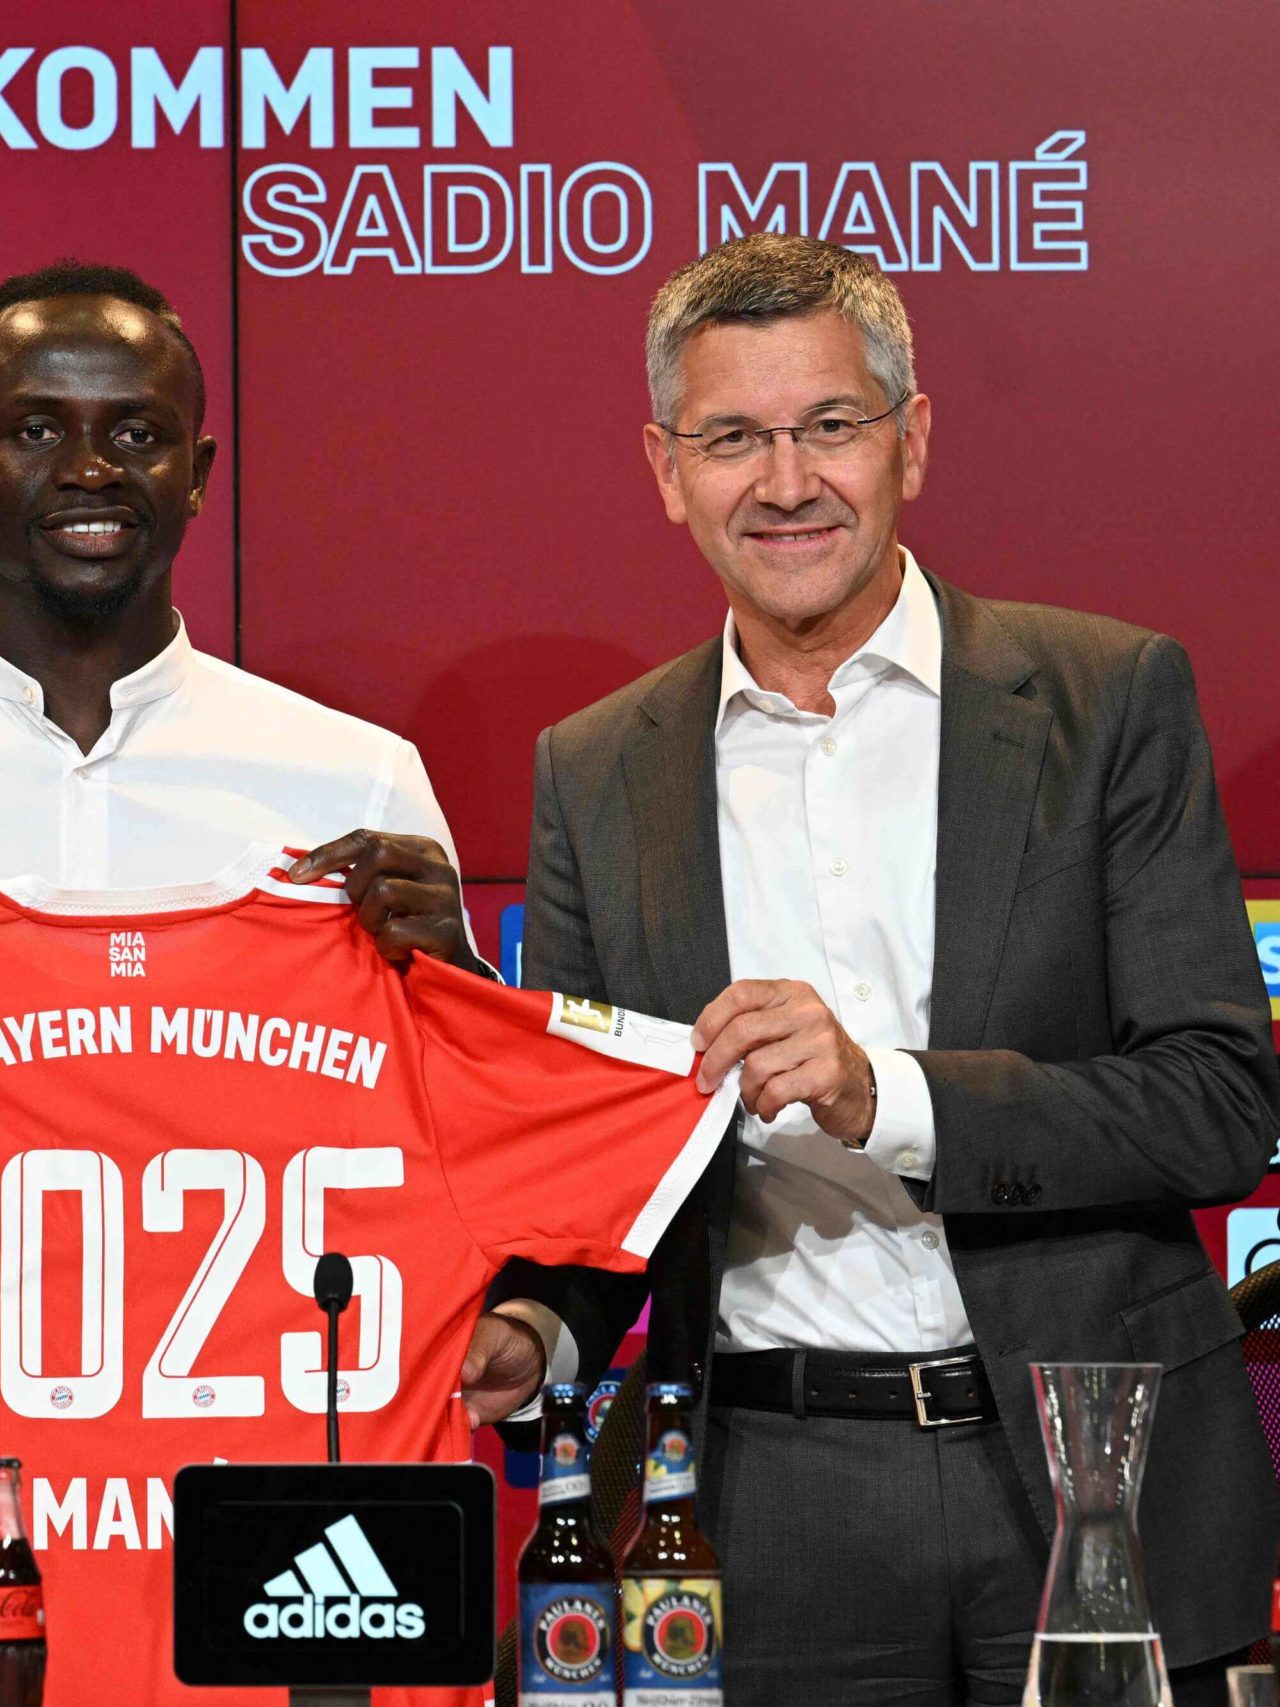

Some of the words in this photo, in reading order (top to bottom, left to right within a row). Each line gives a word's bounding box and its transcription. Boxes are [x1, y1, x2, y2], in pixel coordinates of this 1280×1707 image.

[241, 161, 652, 277] SADIO
[698, 129, 1088, 272] MANÉ
[109, 946, 146, 962] SAN
[110, 932, 145, 947] MIA
[110, 961, 146, 977] MIA
[150, 1006, 387, 1089] MÜNCHEN
[32, 1477, 174, 1550] MAN
[243, 1594, 426, 1639] adidas
[539, 1599, 607, 1631] PAULANER
[646, 1595, 713, 1627] PAULANER
